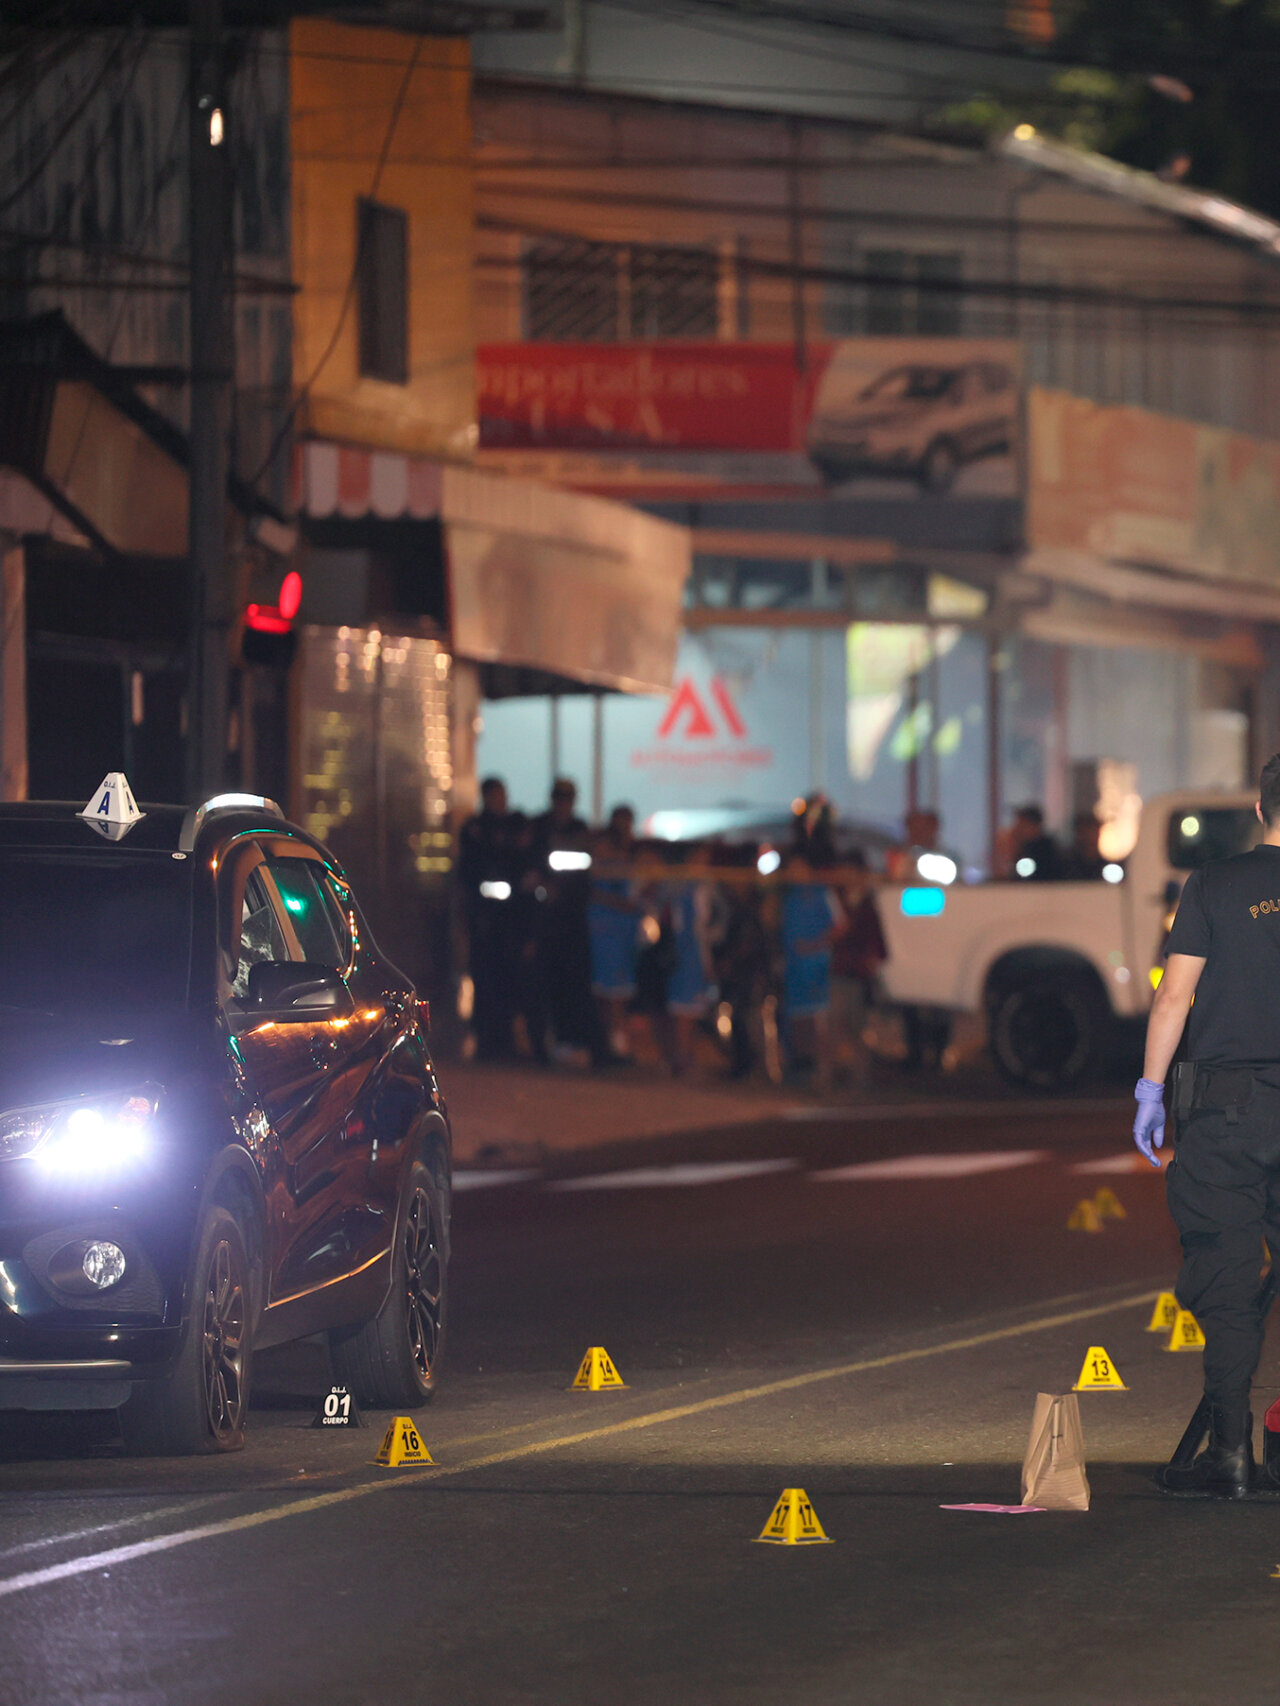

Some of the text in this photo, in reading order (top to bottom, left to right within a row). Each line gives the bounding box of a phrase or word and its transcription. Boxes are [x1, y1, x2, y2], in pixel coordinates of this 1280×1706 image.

[96, 791, 110, 815] A
[599, 1359, 613, 1377] 14
[1091, 1359, 1109, 1377] 13
[323, 1393, 351, 1417] 01
[322, 1416, 349, 1425] CUERPO
[402, 1430, 419, 1451] 16
[774, 1504, 790, 1526] 17
[799, 1504, 813, 1526] 17
